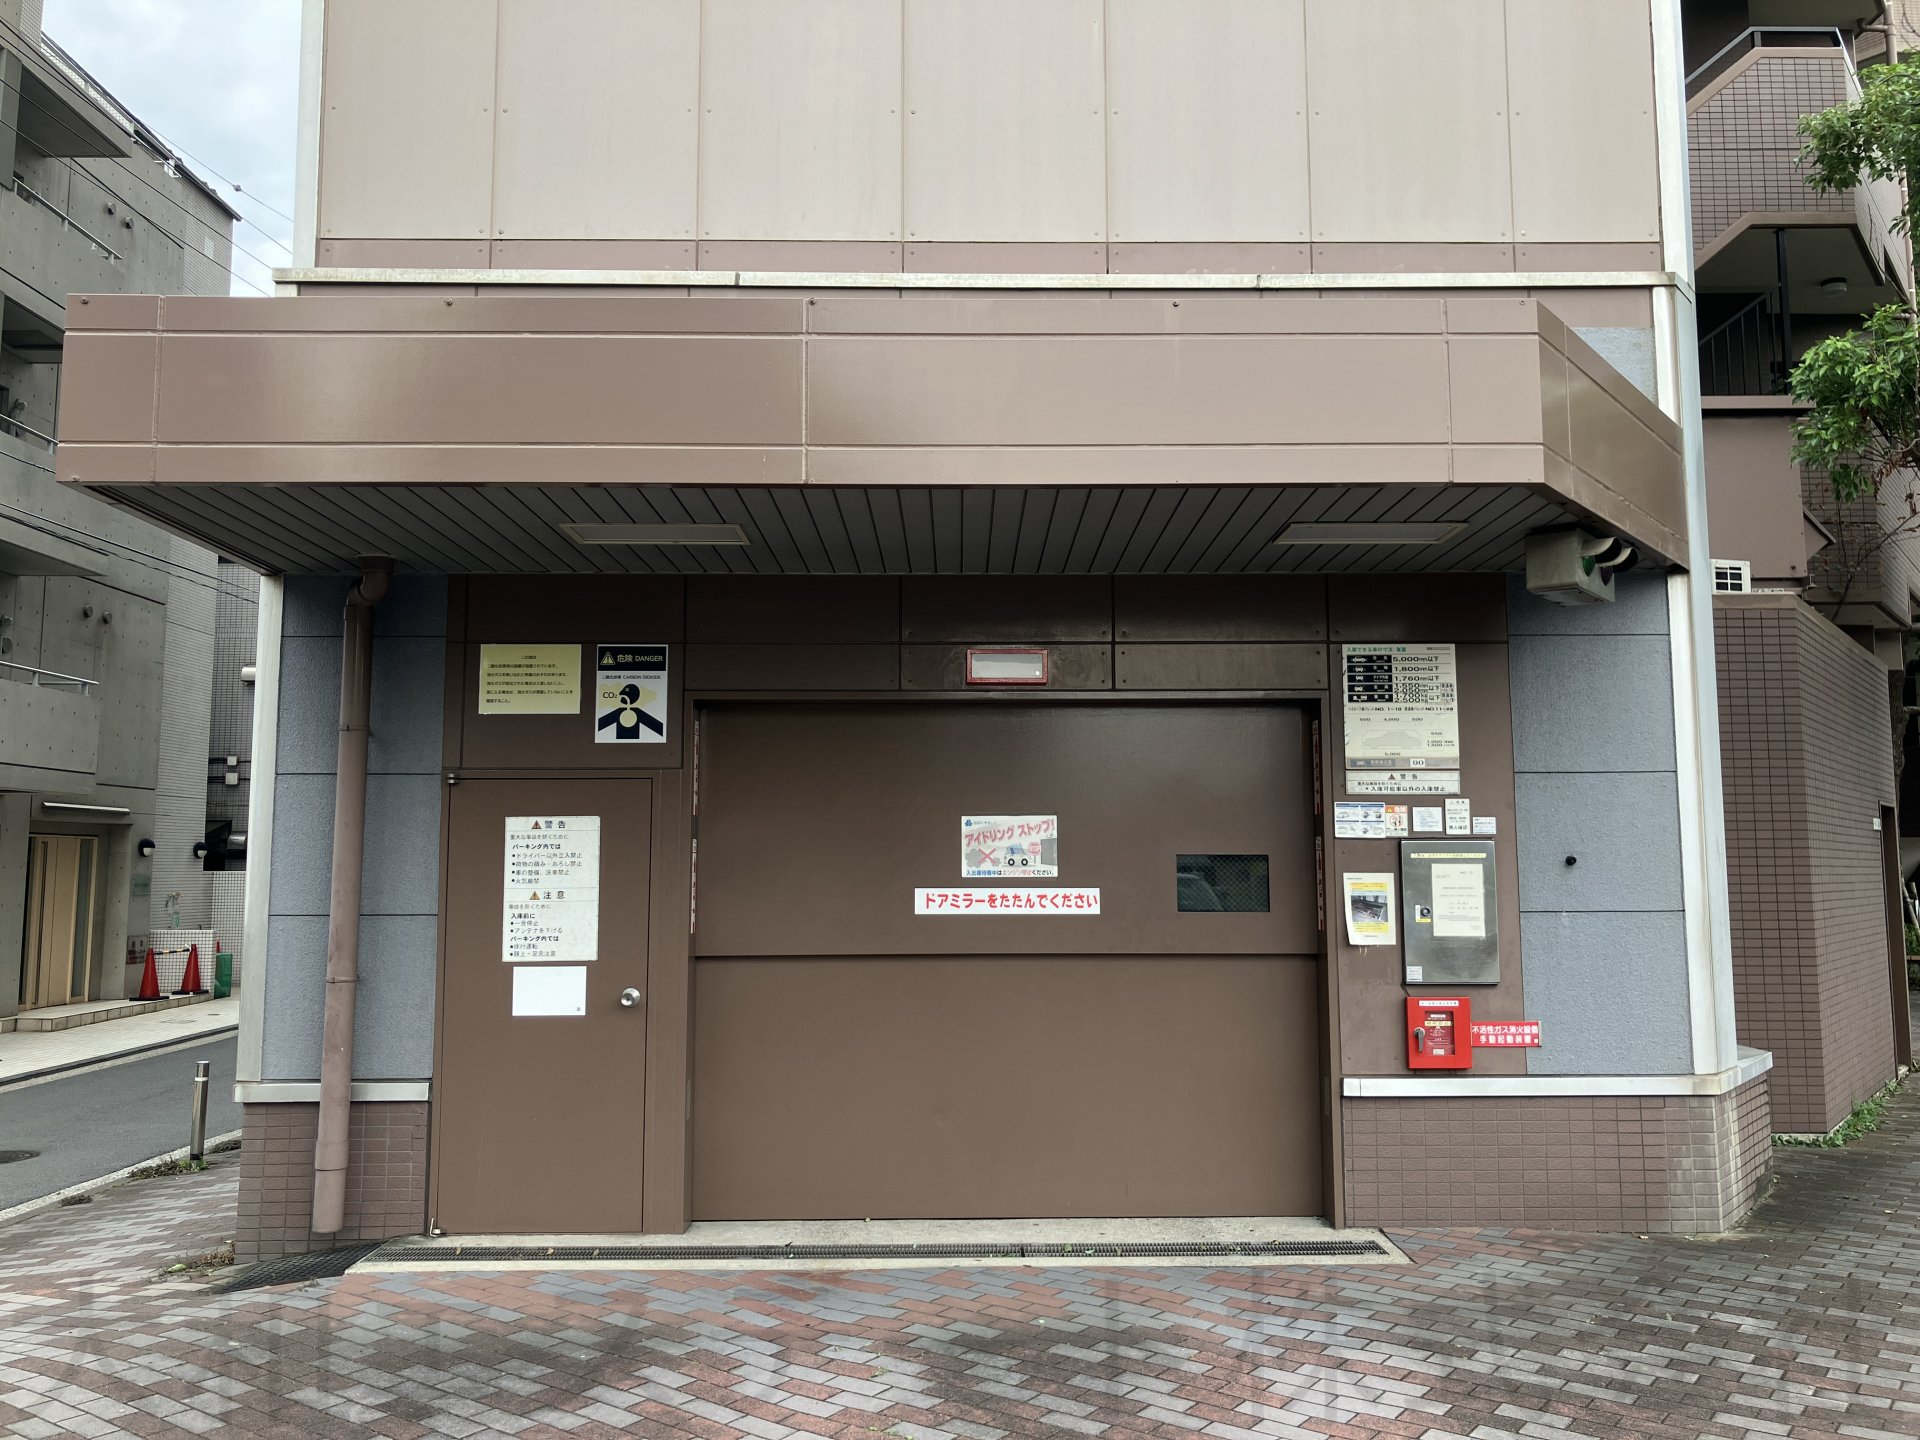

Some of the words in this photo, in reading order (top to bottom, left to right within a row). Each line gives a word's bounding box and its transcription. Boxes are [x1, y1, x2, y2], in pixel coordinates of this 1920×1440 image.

[617, 654, 633, 663] 危険
[544, 820, 566, 829] 警告
[964, 824, 1016, 847] アイドリング
[543, 890, 566, 900] 注意
[925, 892, 1098, 909] ドアミラーをたたんでください
[511, 912, 536, 920] 入庫前に
[1471, 1025, 1539, 1034] 不活性ガス消火設備
[1479, 1035, 1532, 1045] 手動起動装置
